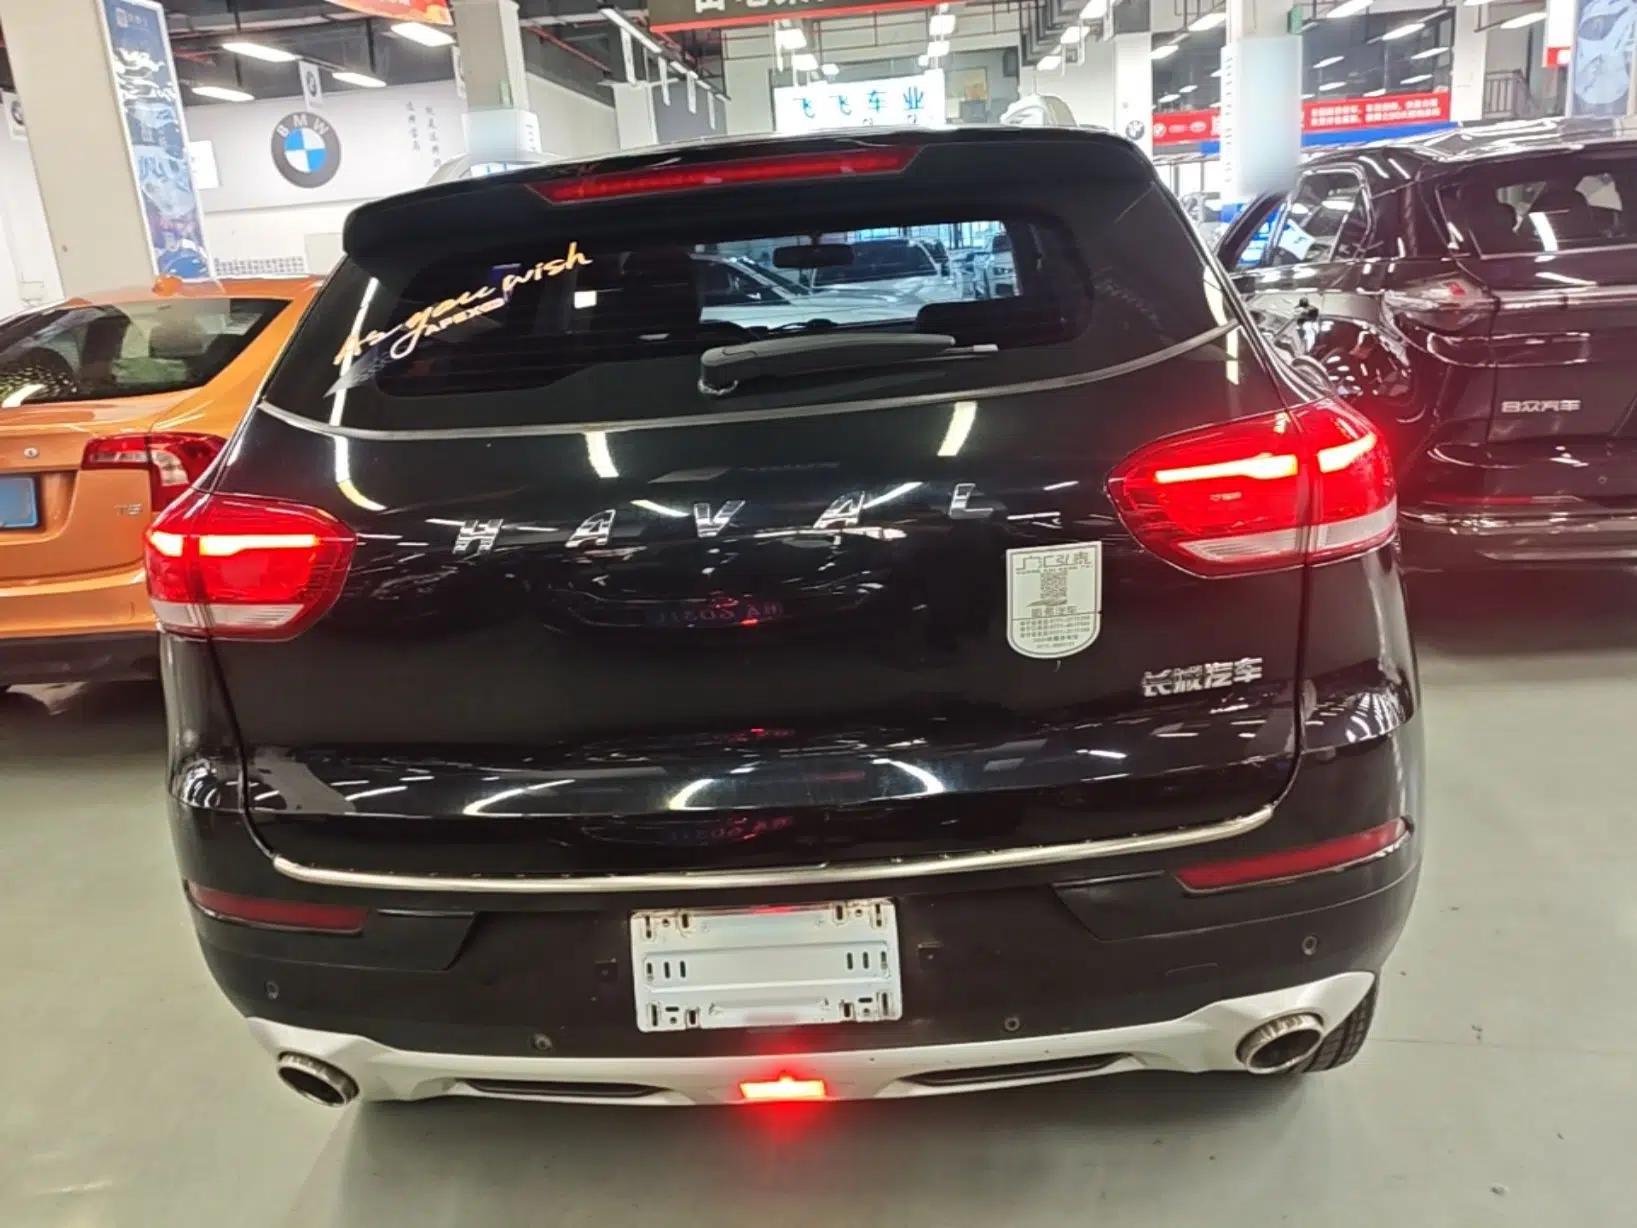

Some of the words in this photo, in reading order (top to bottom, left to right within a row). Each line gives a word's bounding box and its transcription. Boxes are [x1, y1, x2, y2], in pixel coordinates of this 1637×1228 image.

[793, 86, 925, 118] 飞飞车业
[276, 113, 329, 138] BMW
[502, 241, 593, 293] wish
[452, 483, 994, 555] HAVAL
[1142, 657, 1263, 697] 长城汽车
